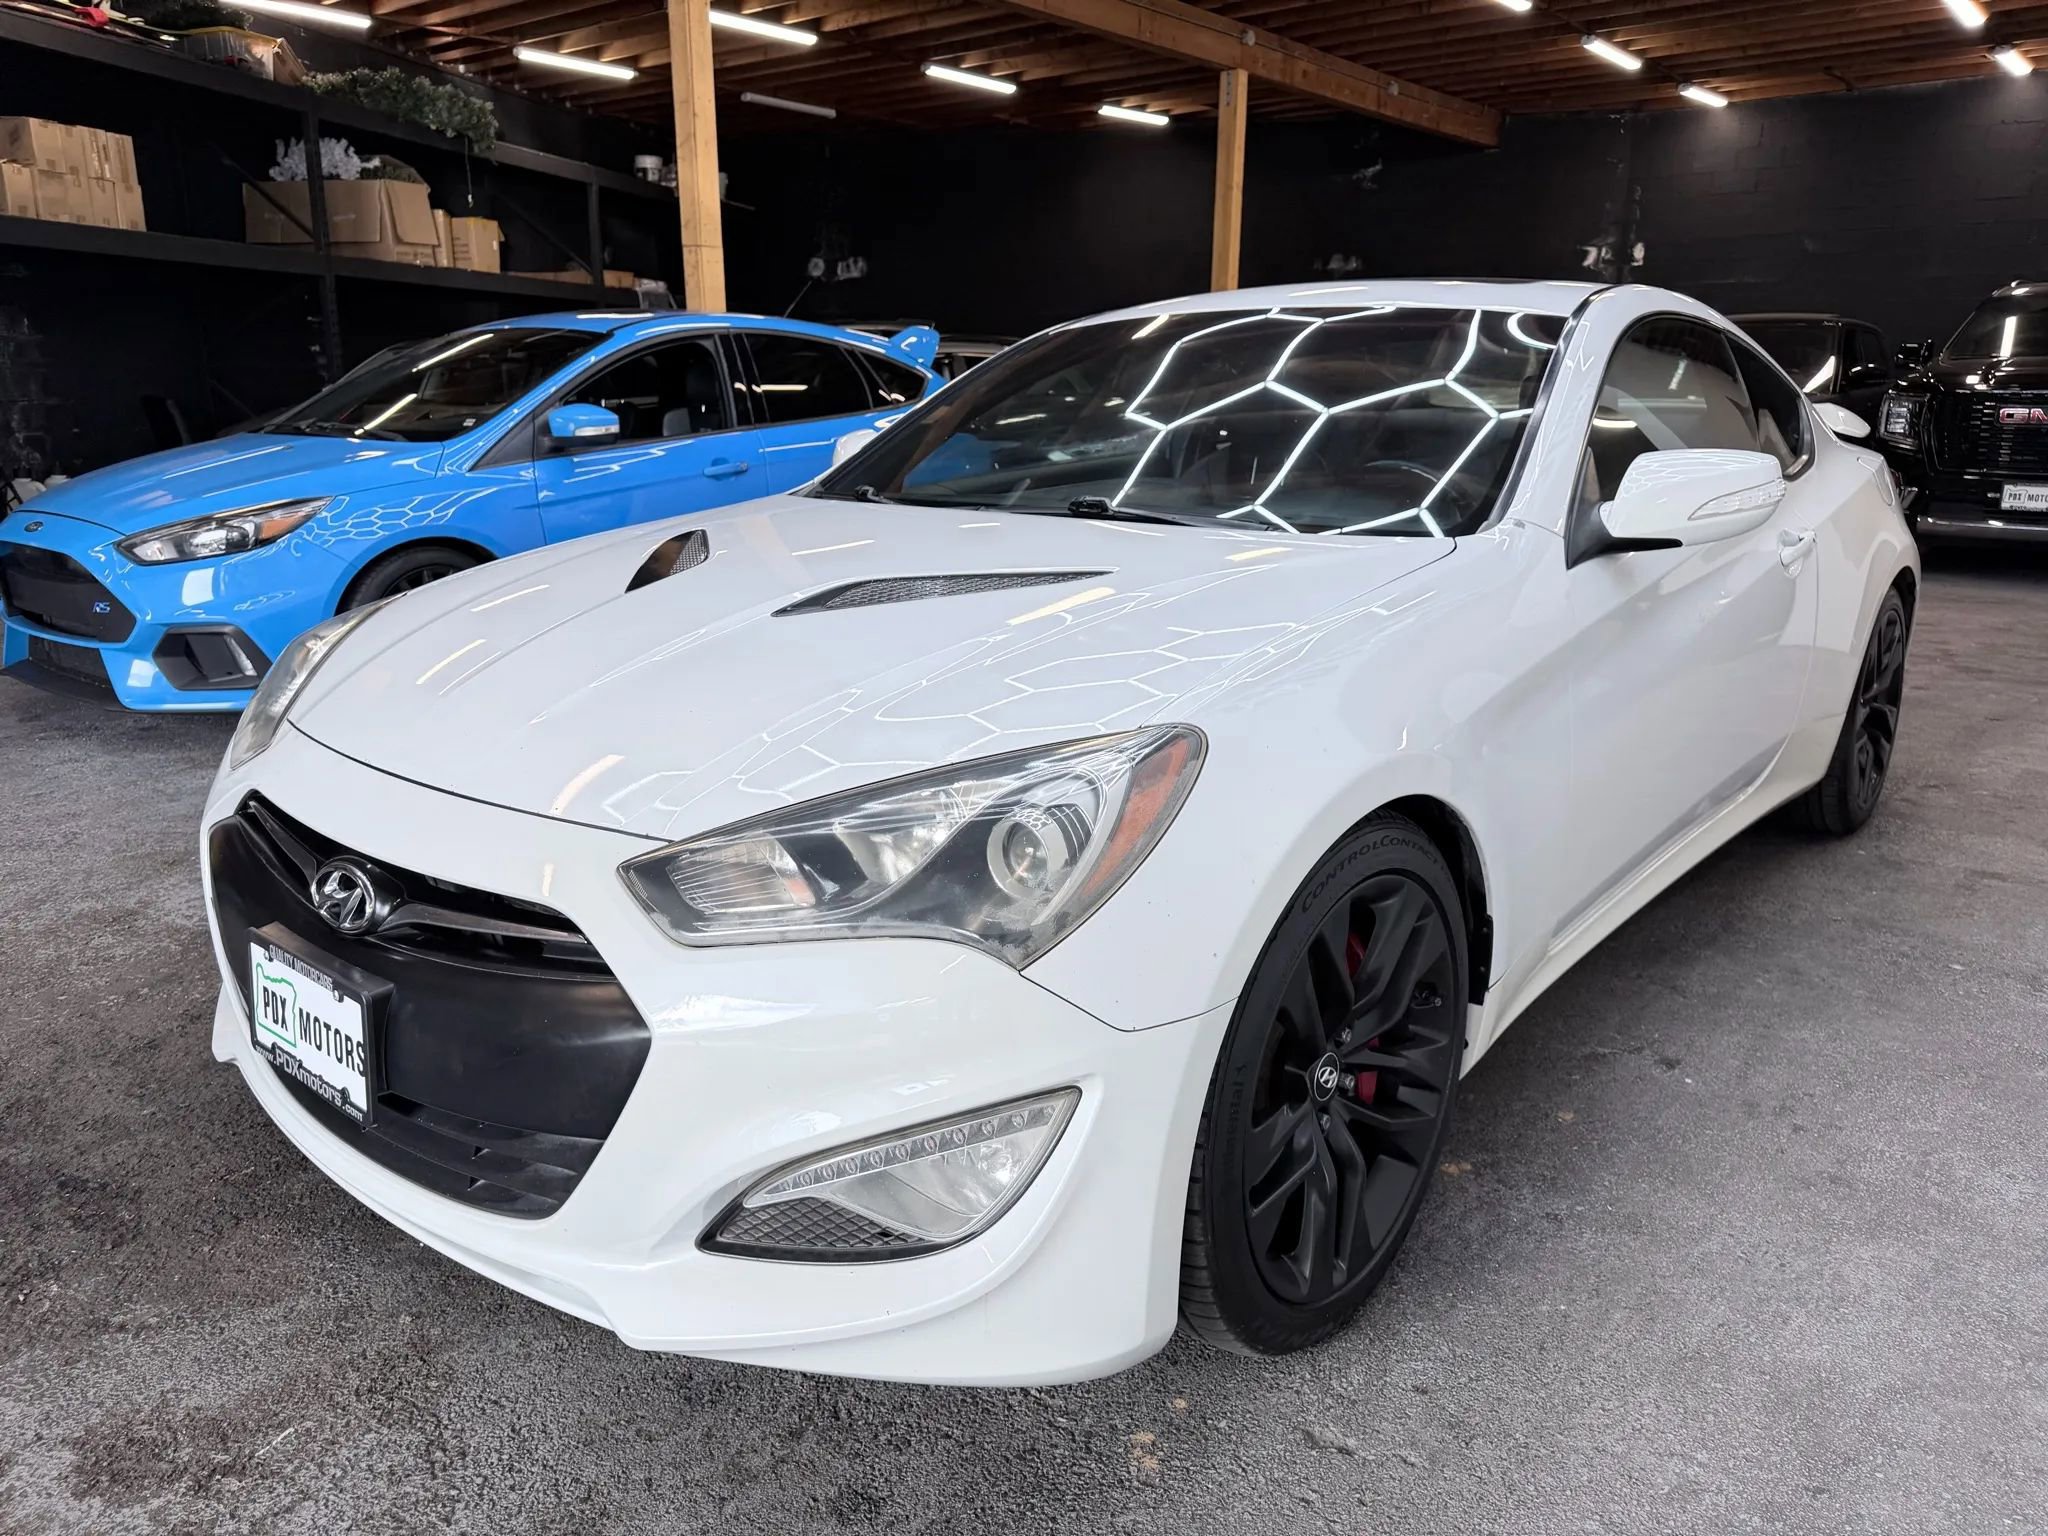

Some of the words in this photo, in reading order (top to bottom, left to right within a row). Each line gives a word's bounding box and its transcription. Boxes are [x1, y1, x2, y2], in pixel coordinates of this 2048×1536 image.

[1999, 408, 2048, 424] GM
[93, 602, 110, 613] RS
[269, 944, 294, 969] QUALITY
[294, 957, 333, 992] MOTORCARS
[263, 985, 288, 1031] PDX
[299, 1007, 366, 1077] MOTORS
